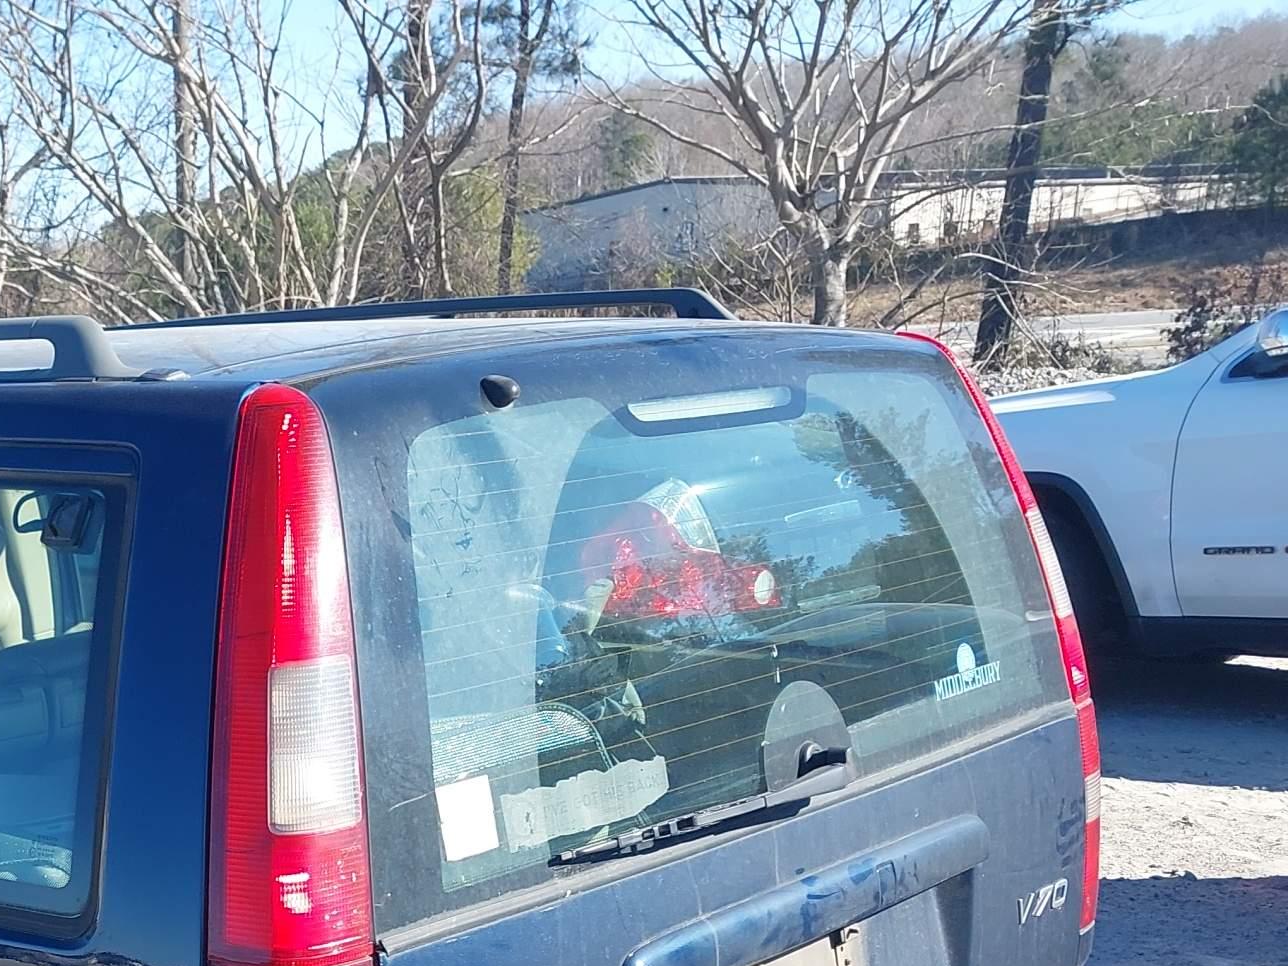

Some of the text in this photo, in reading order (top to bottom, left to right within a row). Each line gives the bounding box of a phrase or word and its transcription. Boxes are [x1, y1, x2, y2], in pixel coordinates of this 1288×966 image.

[1202, 546, 1275, 556] GRAND
[934, 660, 1001, 701] MIDDLEBURY
[1016, 878, 1068, 925] V70
